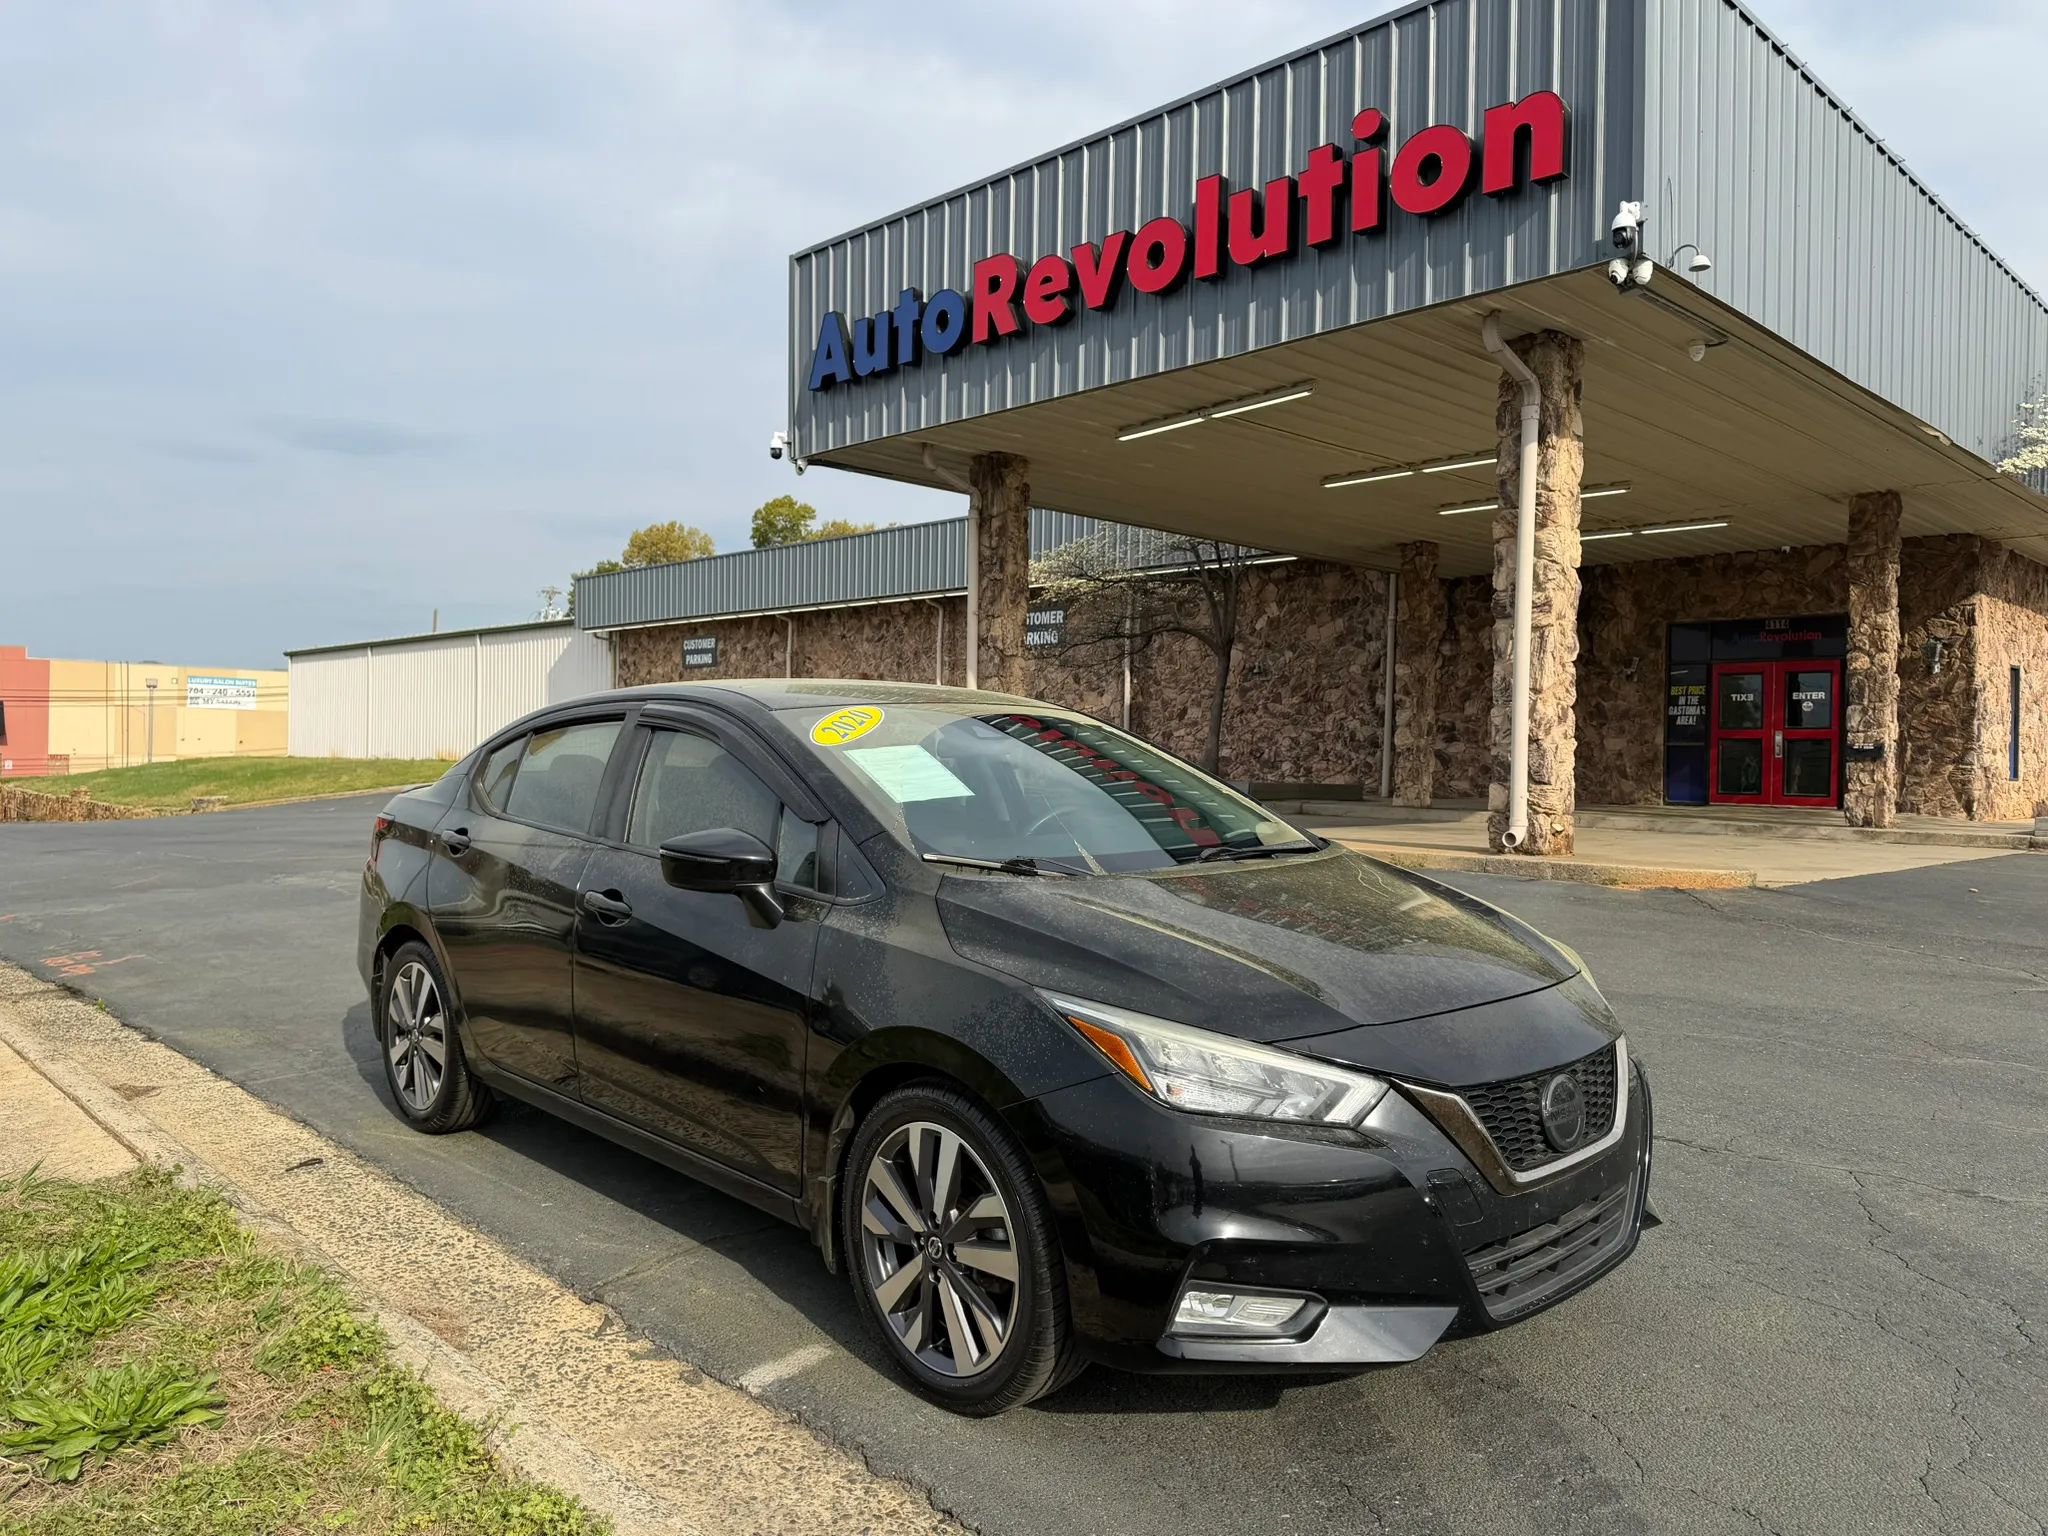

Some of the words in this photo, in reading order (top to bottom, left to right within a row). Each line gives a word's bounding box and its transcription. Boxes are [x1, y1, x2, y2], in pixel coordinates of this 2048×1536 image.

[683, 638, 716, 650] CUSTOMER
[685, 653, 713, 665] PARKING
[1671, 685, 1687, 696] BEST
[1687, 685, 1706, 696] PRICE
[1792, 691, 1825, 700] ENTER
[1678, 695, 1686, 705] IN
[1687, 695, 1700, 705] THE
[821, 709, 873, 740] 2020
[1676, 715, 1697, 726] AREA!
